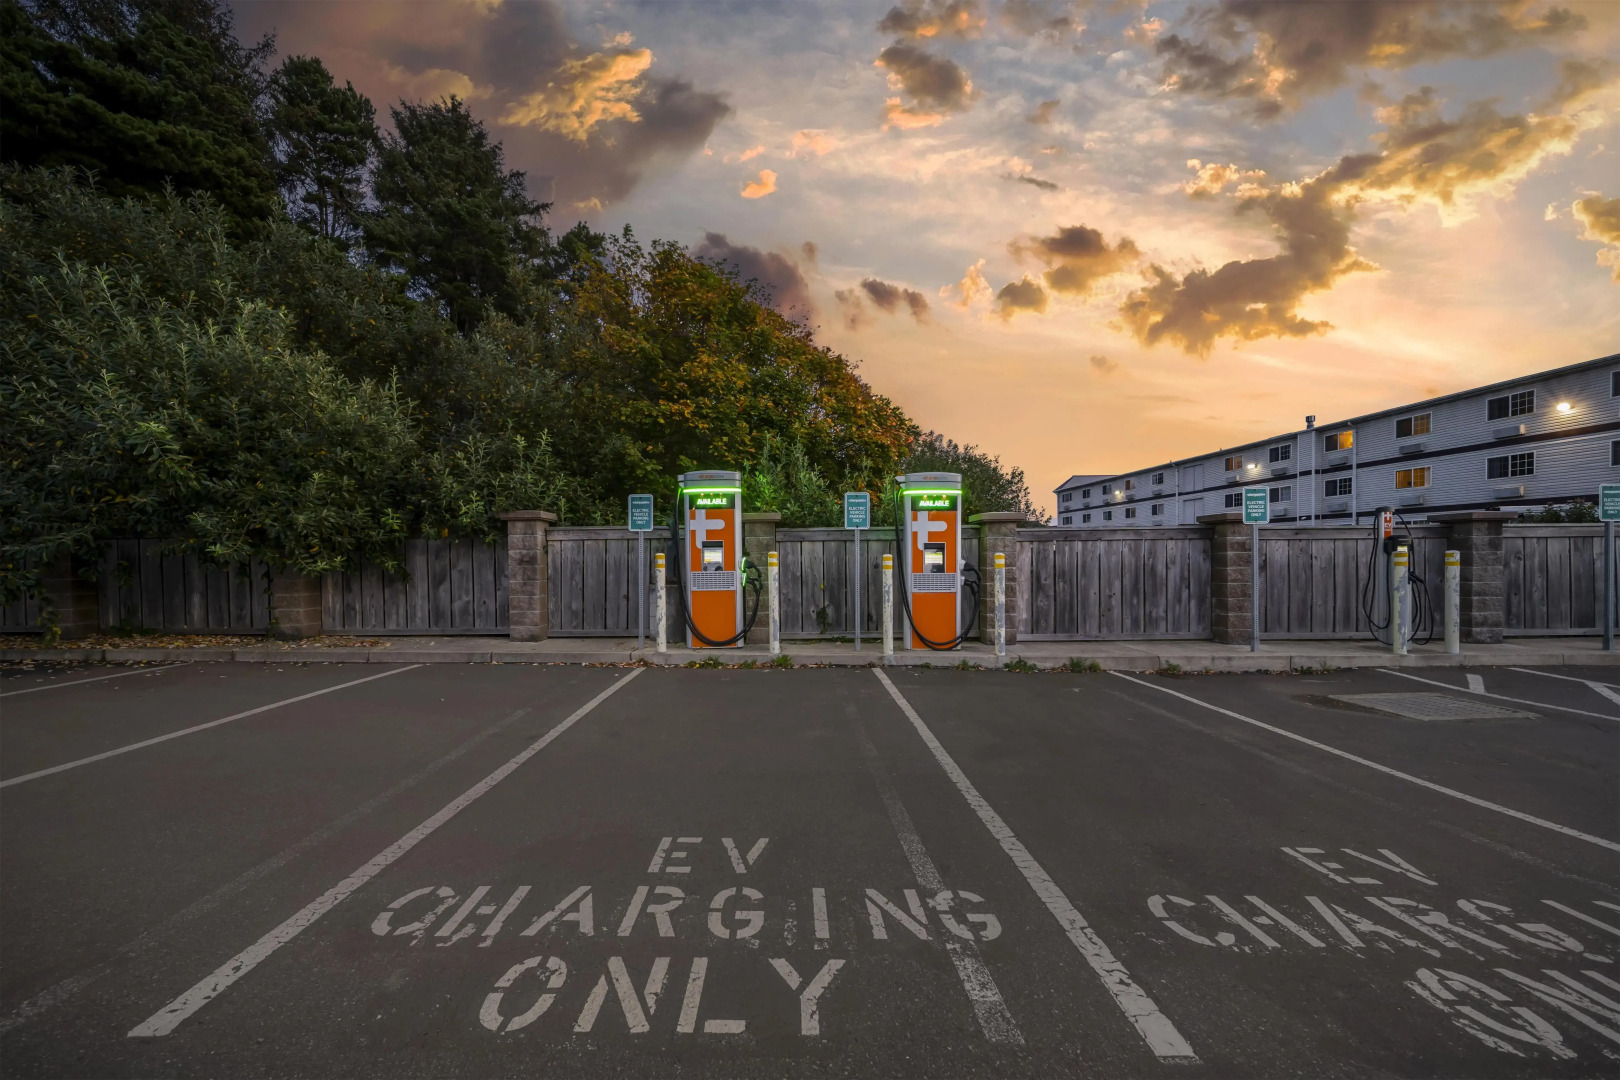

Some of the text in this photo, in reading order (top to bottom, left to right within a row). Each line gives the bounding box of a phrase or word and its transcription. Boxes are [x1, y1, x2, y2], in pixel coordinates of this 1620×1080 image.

[647, 837, 769, 874] EV
[1280, 846, 1439, 885] EV
[370, 885, 1003, 943] CHARGING
[1147, 894, 1620, 958] CHARGI
[479, 956, 846, 1036] ONLY
